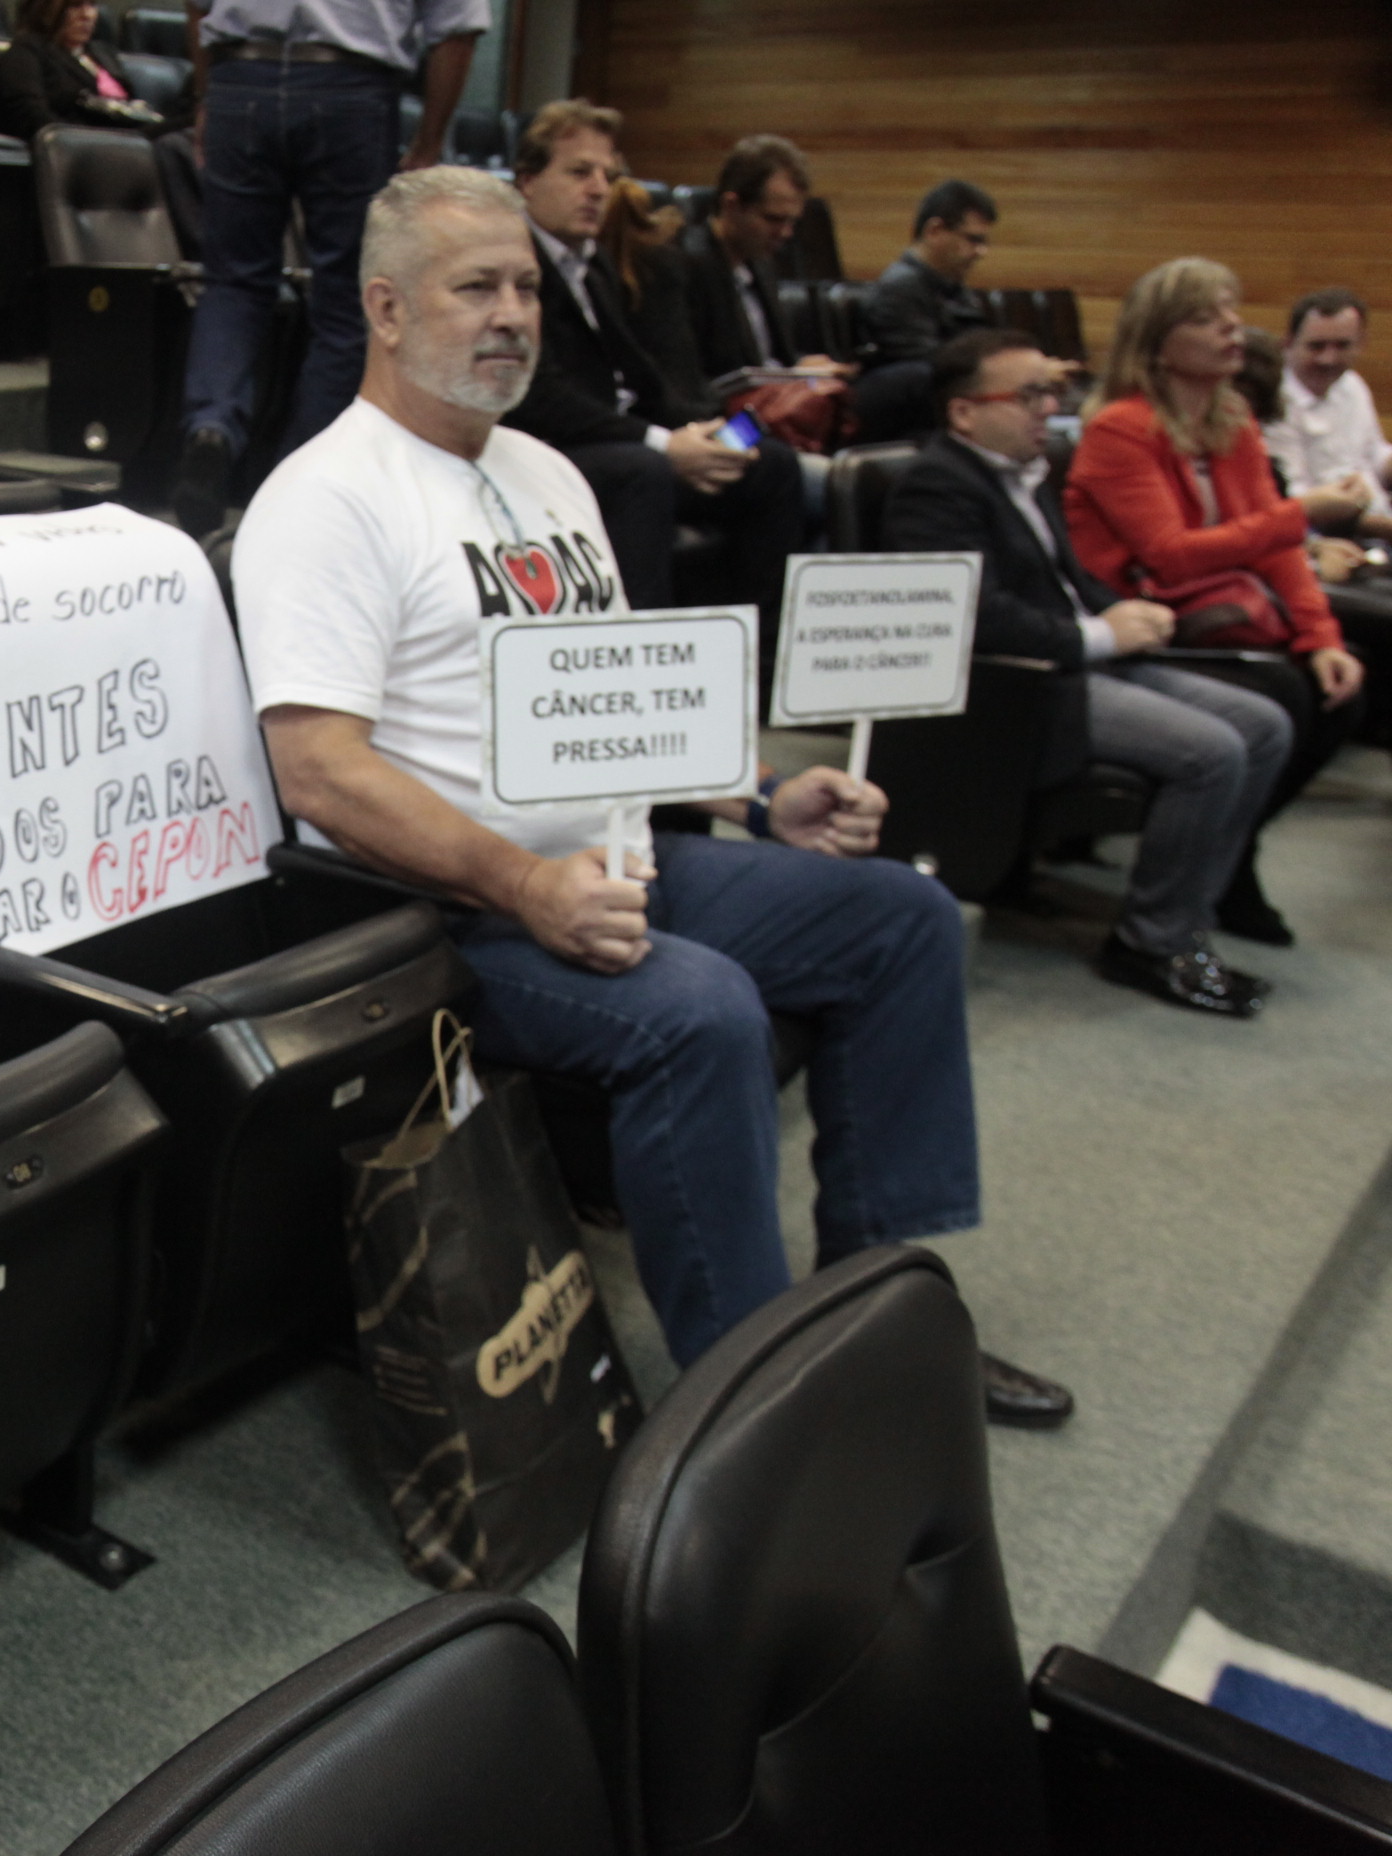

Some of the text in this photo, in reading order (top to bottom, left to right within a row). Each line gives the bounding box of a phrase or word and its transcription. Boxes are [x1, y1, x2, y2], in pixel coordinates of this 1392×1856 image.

[51, 570, 185, 621] socorro
[549, 642, 696, 674] QUEM TEM
[531, 686, 706, 719] CÂNCER, TEM
[552, 731, 687, 764] PRESSA!!!!
[94, 755, 227, 838] PARA
[87, 801, 260, 921] CEPON
